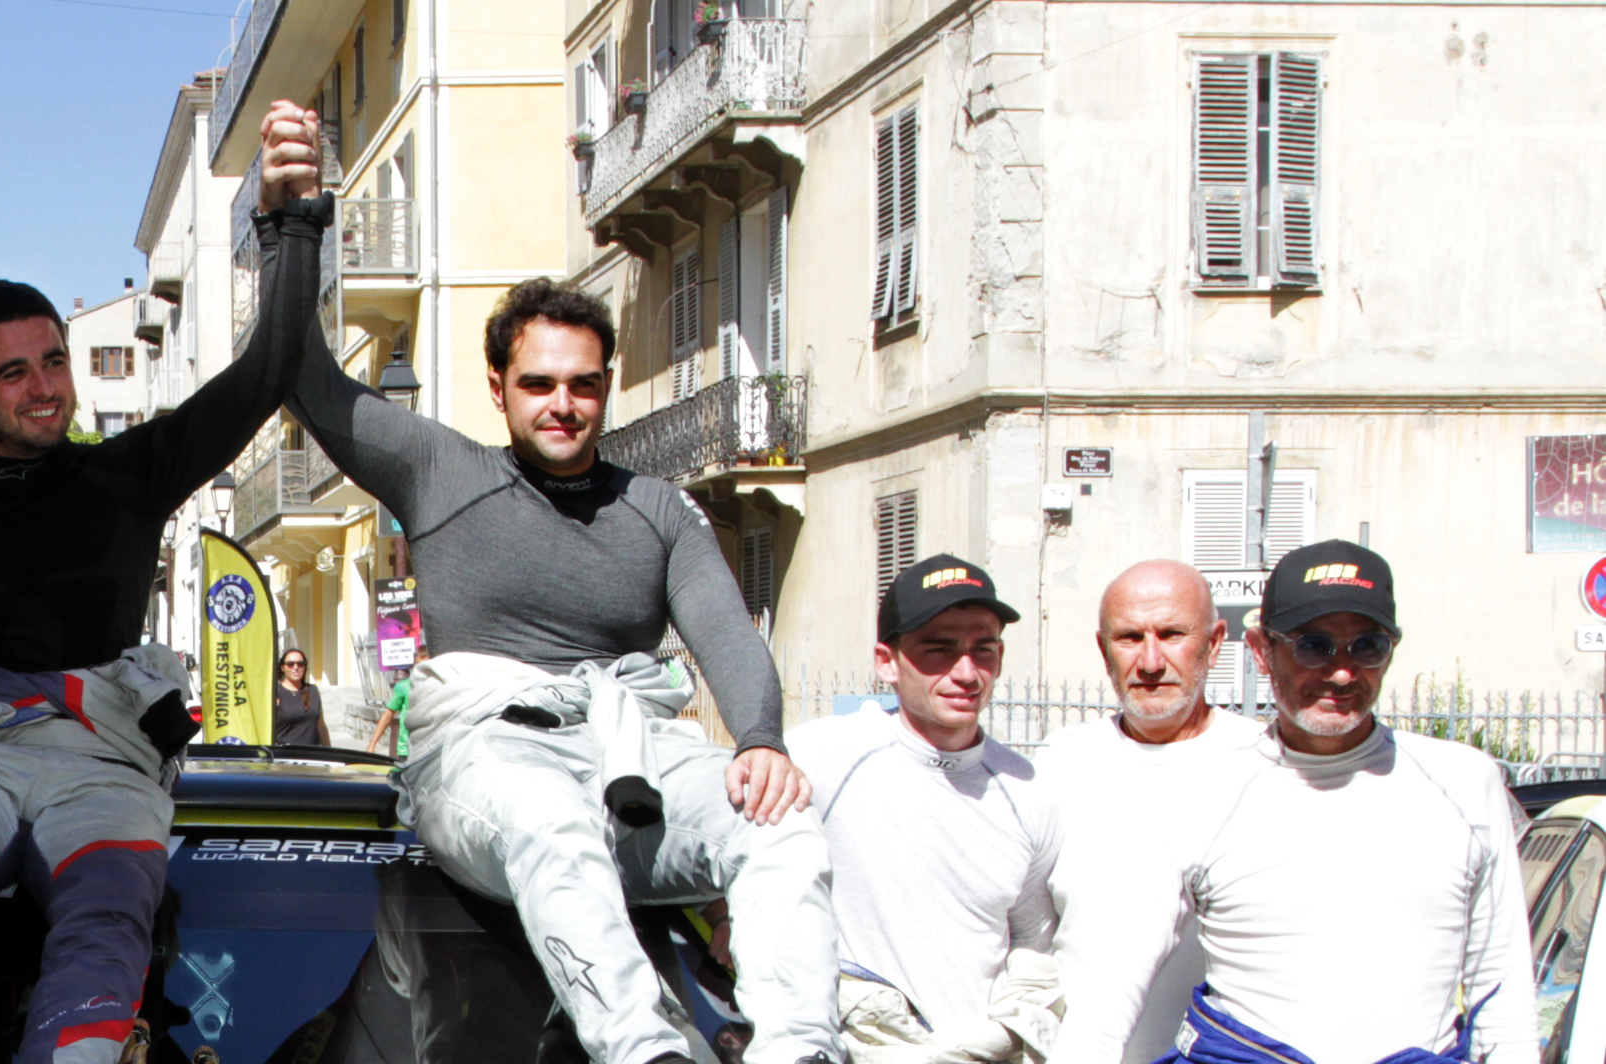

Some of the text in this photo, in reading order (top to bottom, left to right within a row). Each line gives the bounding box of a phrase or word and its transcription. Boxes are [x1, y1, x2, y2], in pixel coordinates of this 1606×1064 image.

[1554, 492, 1584, 516] de
[395, 590, 413, 600] VOIX
[1318, 578, 1374, 590] RACING
[215, 641, 229, 729] RESTONICA
[232, 664, 246, 707] A.S.A
